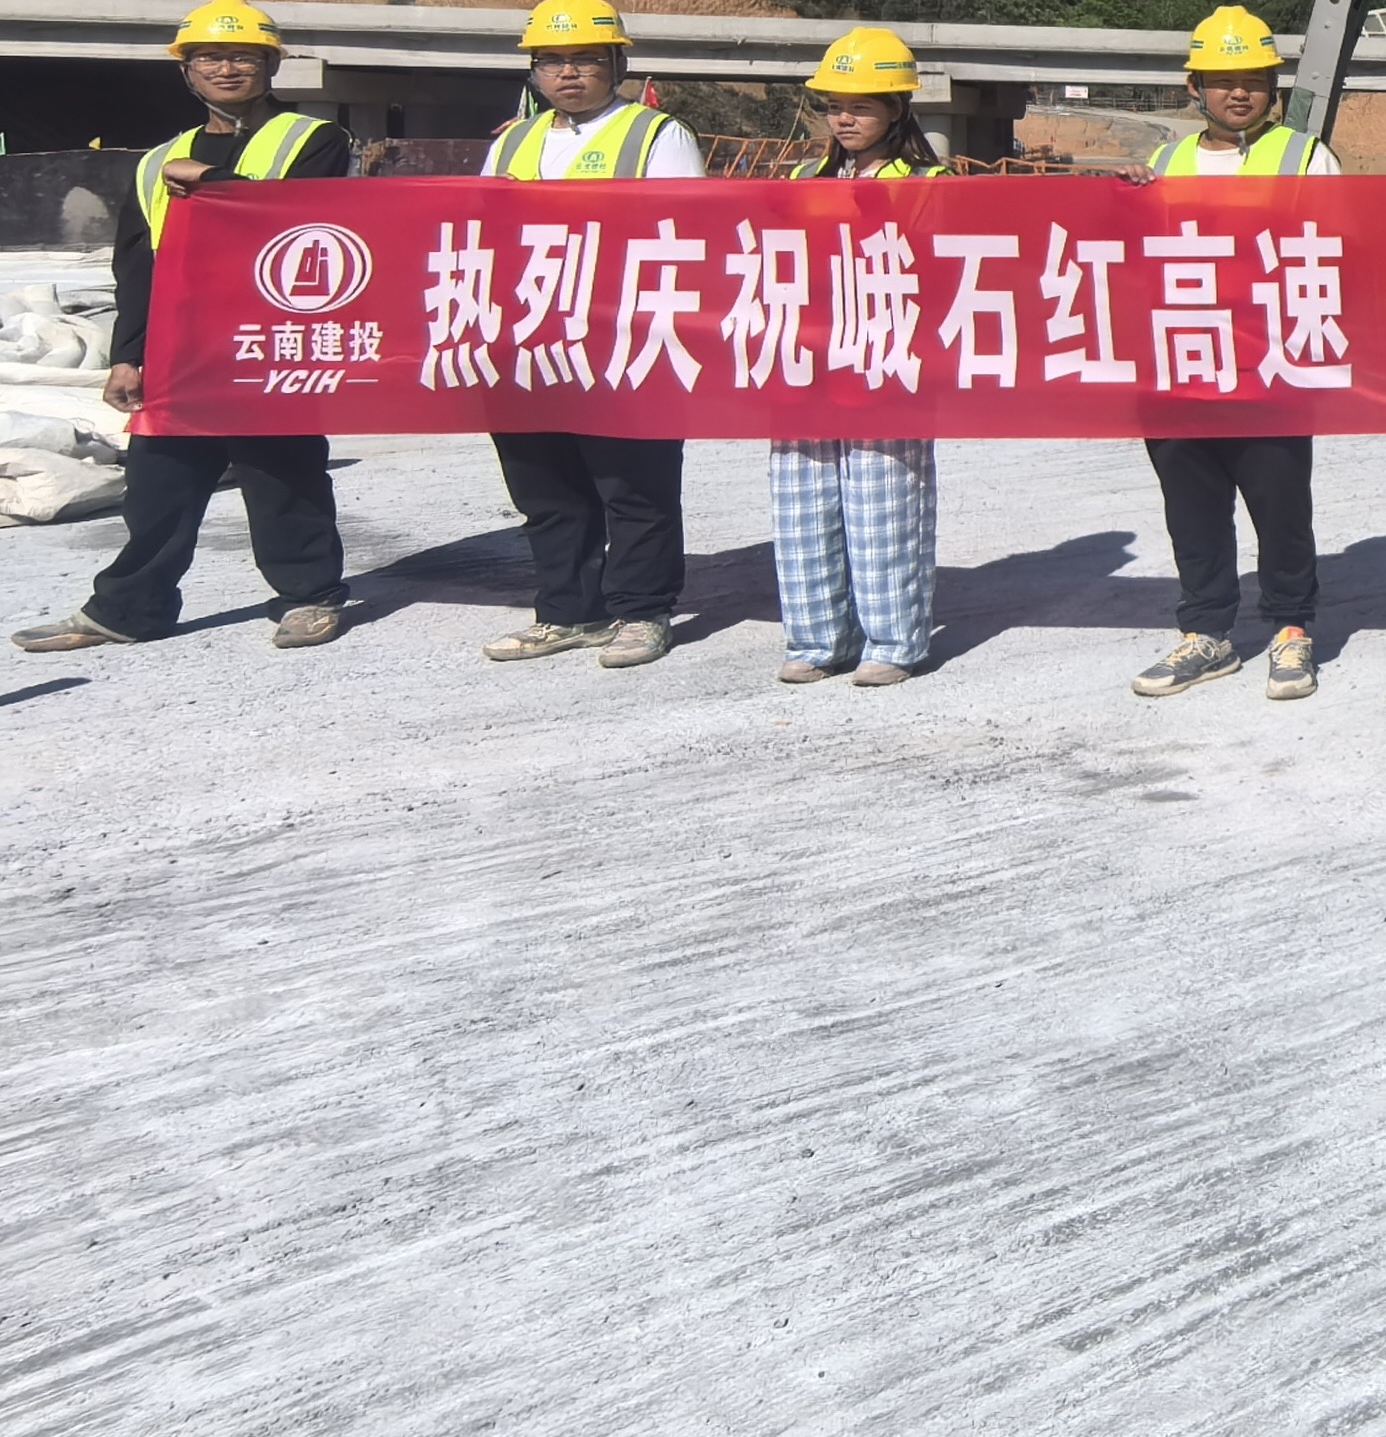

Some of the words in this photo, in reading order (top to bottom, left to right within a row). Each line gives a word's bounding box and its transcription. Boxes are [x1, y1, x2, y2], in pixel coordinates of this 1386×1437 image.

[233, 319, 383, 363] 云南建投
[263, 369, 345, 394] YCIH
